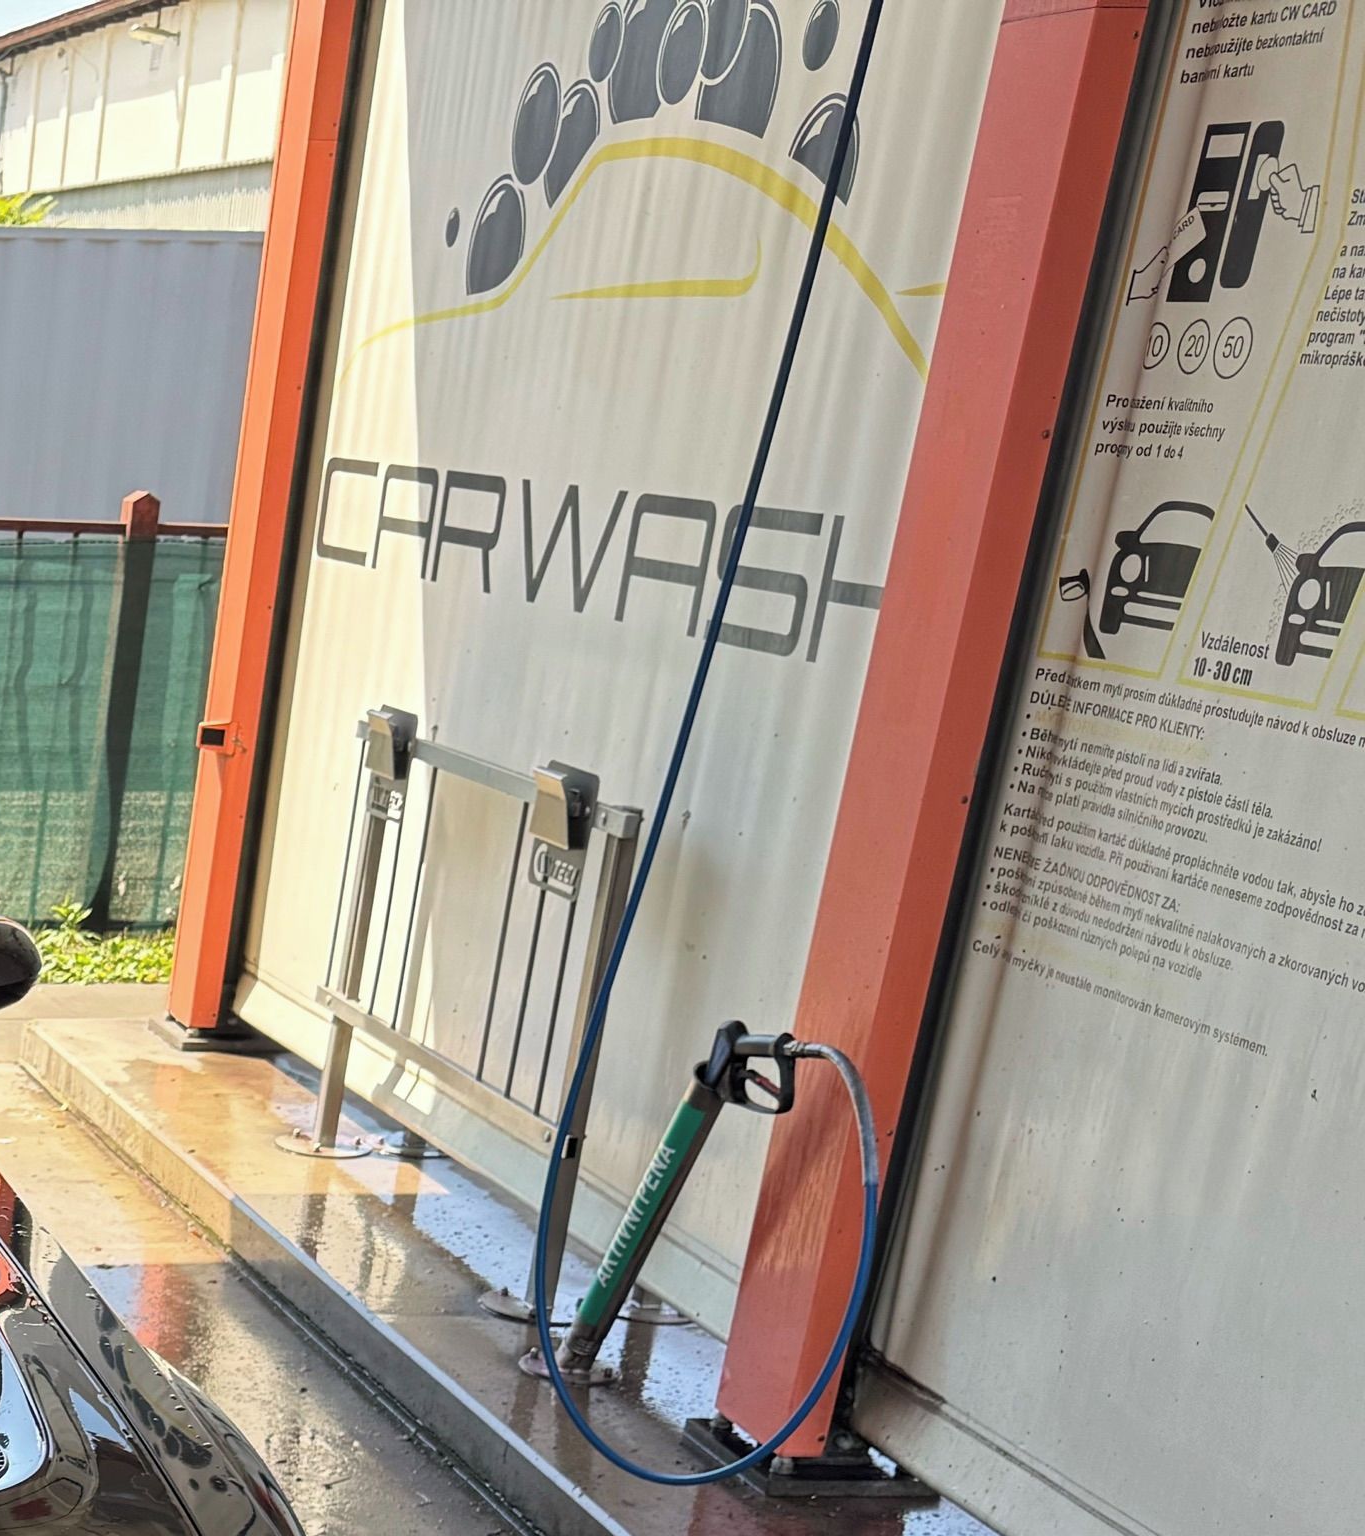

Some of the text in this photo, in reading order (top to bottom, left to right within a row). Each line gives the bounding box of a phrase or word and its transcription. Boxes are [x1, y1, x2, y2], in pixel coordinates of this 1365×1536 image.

[1250, 11, 1278, 26] kartu
[1280, 5, 1301, 22] CW
[1302, 0, 1337, 19] CARD
[1255, 27, 1325, 50] bezkontaktní
[1223, 63, 1255, 78] kartu
[1340, 244, 1347, 257] a
[1332, 266, 1346, 279] na
[1324, 285, 1352, 304] Lépe
[1184, 334, 1205, 358] 20
[1222, 335, 1244, 359] 50
[1306, 331, 1355, 348] program
[1105, 394, 1129, 408] Pro
[1138, 420, 1182, 438] použijte
[1184, 422, 1226, 442] všechny
[1136, 444, 1152, 457] od
[1156, 444, 1162, 458] 1
[1164, 445, 1176, 459] do
[1177, 445, 1184, 459] 4
[1201, 631, 1270, 660] Vzdálenost
[1232, 665, 1253, 686] cm
[1035, 667, 1066, 684] Před
[1103, 683, 1123, 699] mytí
[1123, 688, 1156, 704] prosím
[1158, 692, 1202, 713] důkladně
[1203, 704, 1264, 728] prostudujte
[1266, 715, 1301, 734] návod
[1302, 721, 1310, 736] k
[1311, 724, 1356, 746] obsluze
[1072, 701, 1134, 725] INFORMACE
[1135, 713, 1157, 729] PRO
[1159, 718, 1205, 741] KLIENTY:
[1147, 758, 1160, 770] na
[1178, 766, 1184, 776] a
[1186, 766, 1223, 786] zvířata.
[1102, 765, 1123, 780] před
[1124, 771, 1154, 788] proud
[1156, 780, 1178, 797] vody
[1179, 786, 1186, 797] z
[1187, 786, 1223, 806] pistole
[1251, 801, 1273, 819] těla.
[1017, 780, 1035, 794] Na
[1054, 792, 1080, 808] platí
[1081, 799, 1116, 818] pravidla
[1117, 808, 1164, 830] silničního
[1165, 822, 1208, 843] provozu.
[1065, 777, 1072, 787] s
[1115, 787, 1158, 809] vlastních
[1159, 802, 1194, 819] mycích
[1195, 810, 1252, 834] prostředků
[1252, 821, 1265, 839] je
[1266, 828, 1323, 853] zakázáno!
[999, 820, 1007, 833] k
[1050, 834, 1073, 851] laku
[1109, 850, 1123, 866] Při
[1123, 858, 1169, 880] používání
[1170, 869, 1209, 892] kartáče
[1210, 883, 1263, 908] neneseme
[1264, 899, 1344, 932] zodpovědnost
[1344, 922, 1359, 936] za
[1097, 827, 1127, 847] kartáč
[1128, 838, 1171, 860] důkladně
[1172, 852, 1239, 880] propláchněte
[1242, 871, 1274, 890] vodou
[1276, 880, 1296, 898] tak,
[1299, 887, 1336, 908] abyste
[1338, 896, 1354, 913] ho
[1086, 873, 1161, 907] ODPOVĚDNOST
[1161, 896, 1181, 913] ZA:
[1033, 916, 1079, 938] poškození
[1080, 930, 1118, 951] různých
[1119, 943, 1150, 964] polepů
[1152, 955, 1166, 968] na
[1168, 960, 1203, 981] vozidle
[1052, 902, 1058, 912] z
[1092, 915, 1144, 941] nedodržení
[1144, 932, 1182, 953] návodu
[1184, 942, 1190, 956] k
[1192, 948, 1233, 971] obsluze.
[1089, 894, 1121, 914] během
[1122, 905, 1144, 921] mytí
[1196, 930, 1266, 960] nalakovaných
[1268, 952, 1276, 964] a
[1278, 954, 1349, 987] zkorovaných
[972, 940, 1001, 959] Celý
[1011, 956, 1046, 977] myčky
[1046, 964, 1054, 979] je
[1055, 971, 1092, 992] neustále
[1093, 984, 1152, 1014] monitorován
[1153, 1003, 1211, 1035] kamerovým
[1212, 1026, 1268, 1057] systémem.
